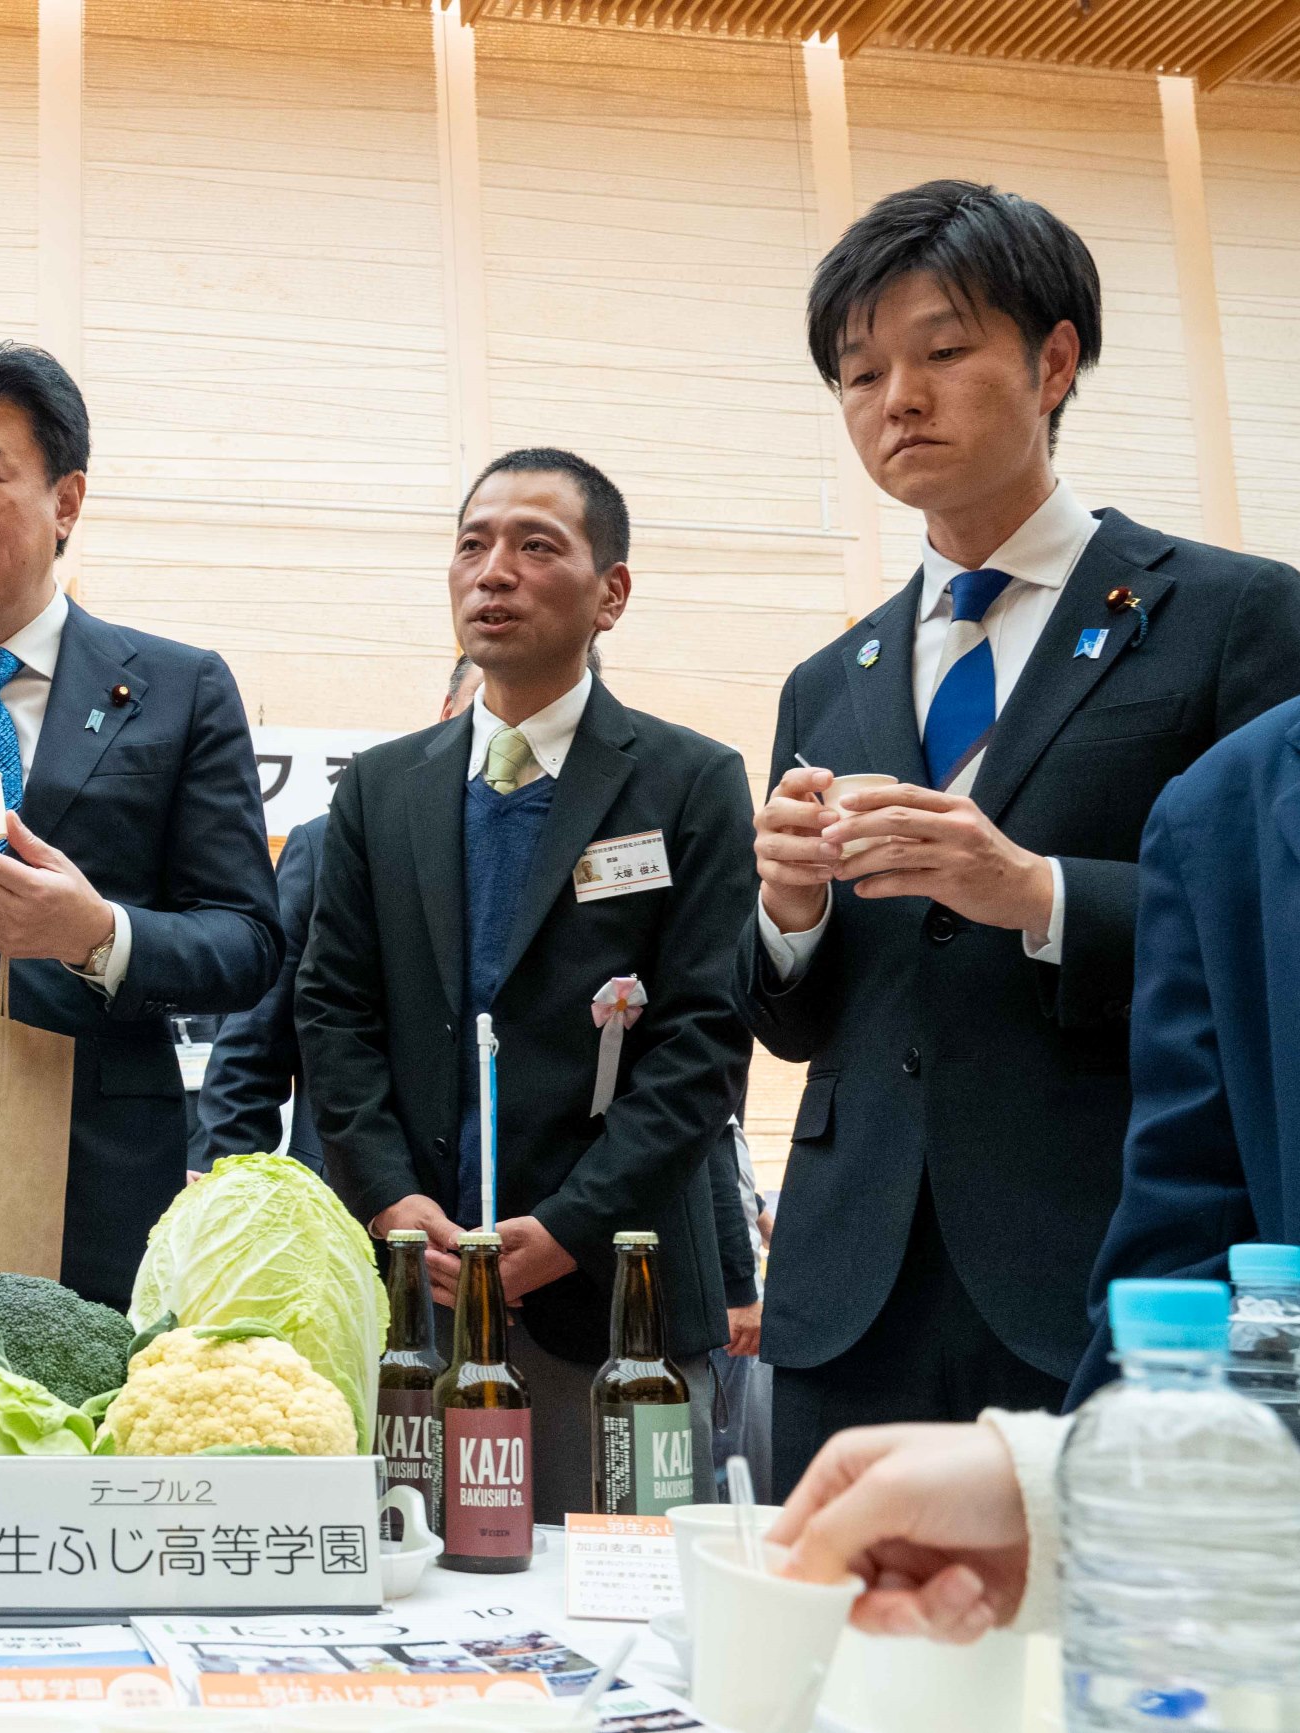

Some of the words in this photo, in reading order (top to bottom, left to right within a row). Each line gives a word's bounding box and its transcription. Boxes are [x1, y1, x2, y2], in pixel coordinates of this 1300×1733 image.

[460, 1437, 524, 1485] KAZO
[652, 1429, 693, 1477] KAZ
[90, 1479, 213, 1504] テーブル2
[460, 1488, 508, 1507] BAKUSHU
[510, 1488, 524, 1507] Co.
